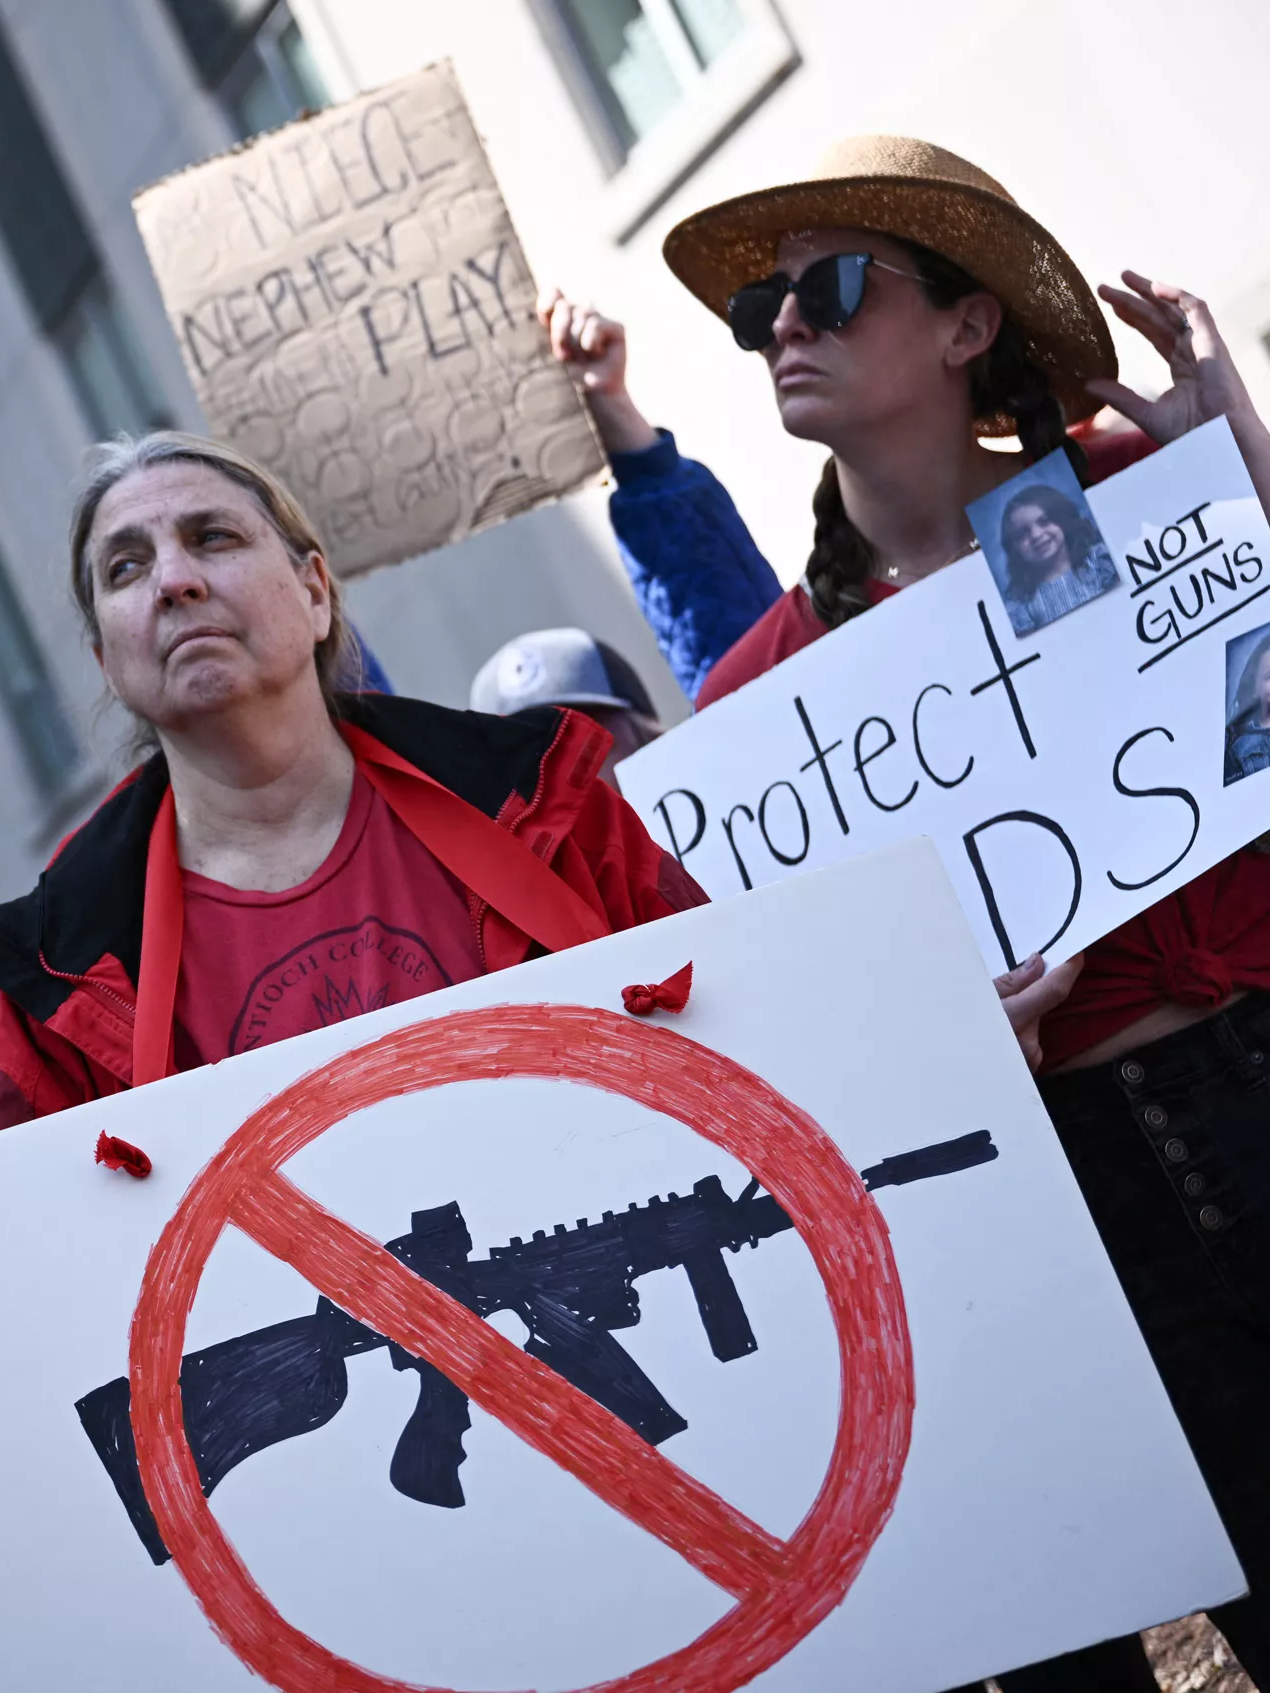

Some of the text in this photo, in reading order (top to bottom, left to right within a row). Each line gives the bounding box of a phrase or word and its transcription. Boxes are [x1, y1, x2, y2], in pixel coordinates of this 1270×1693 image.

[231, 92, 459, 251] NIECE
[180, 221, 398, 377] NEPHEW
[360, 241, 516, 377] PLAY
[1125, 502, 1213, 575] NOT
[1136, 541, 1265, 645] GUNS
[653, 600, 1041, 891] Protect
[962, 726, 1201, 972] DS
[244, 930, 429, 1051] NTIOCH COLLEGE
